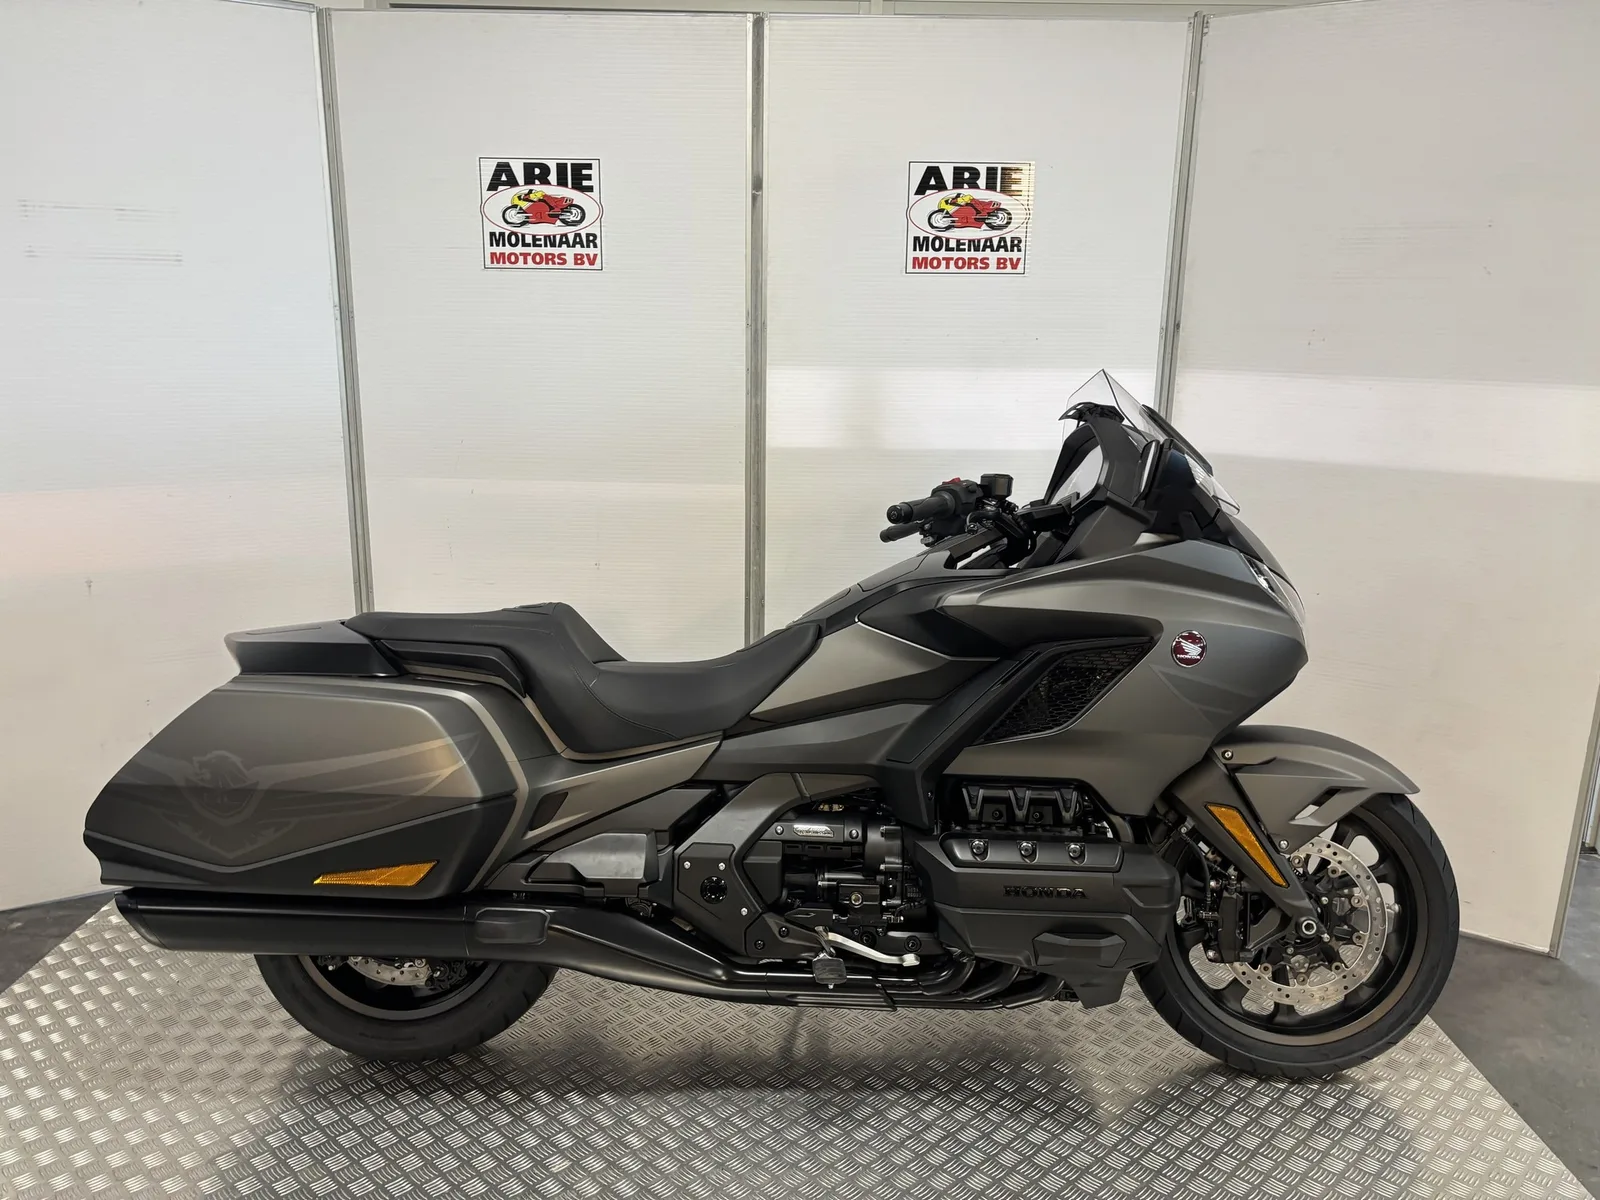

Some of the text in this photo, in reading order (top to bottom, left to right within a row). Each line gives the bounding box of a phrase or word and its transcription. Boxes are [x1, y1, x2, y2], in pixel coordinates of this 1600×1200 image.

[486, 162, 594, 193] ARIE
[914, 166, 1023, 196] ARIE
[489, 232, 598, 248] MOLENAAR
[913, 236, 1022, 252] MOLENAAR
[490, 252, 598, 266] MOTORS BV
[912, 257, 1021, 270] MOTORS BV
[1003, 885, 1088, 899] HONDA
